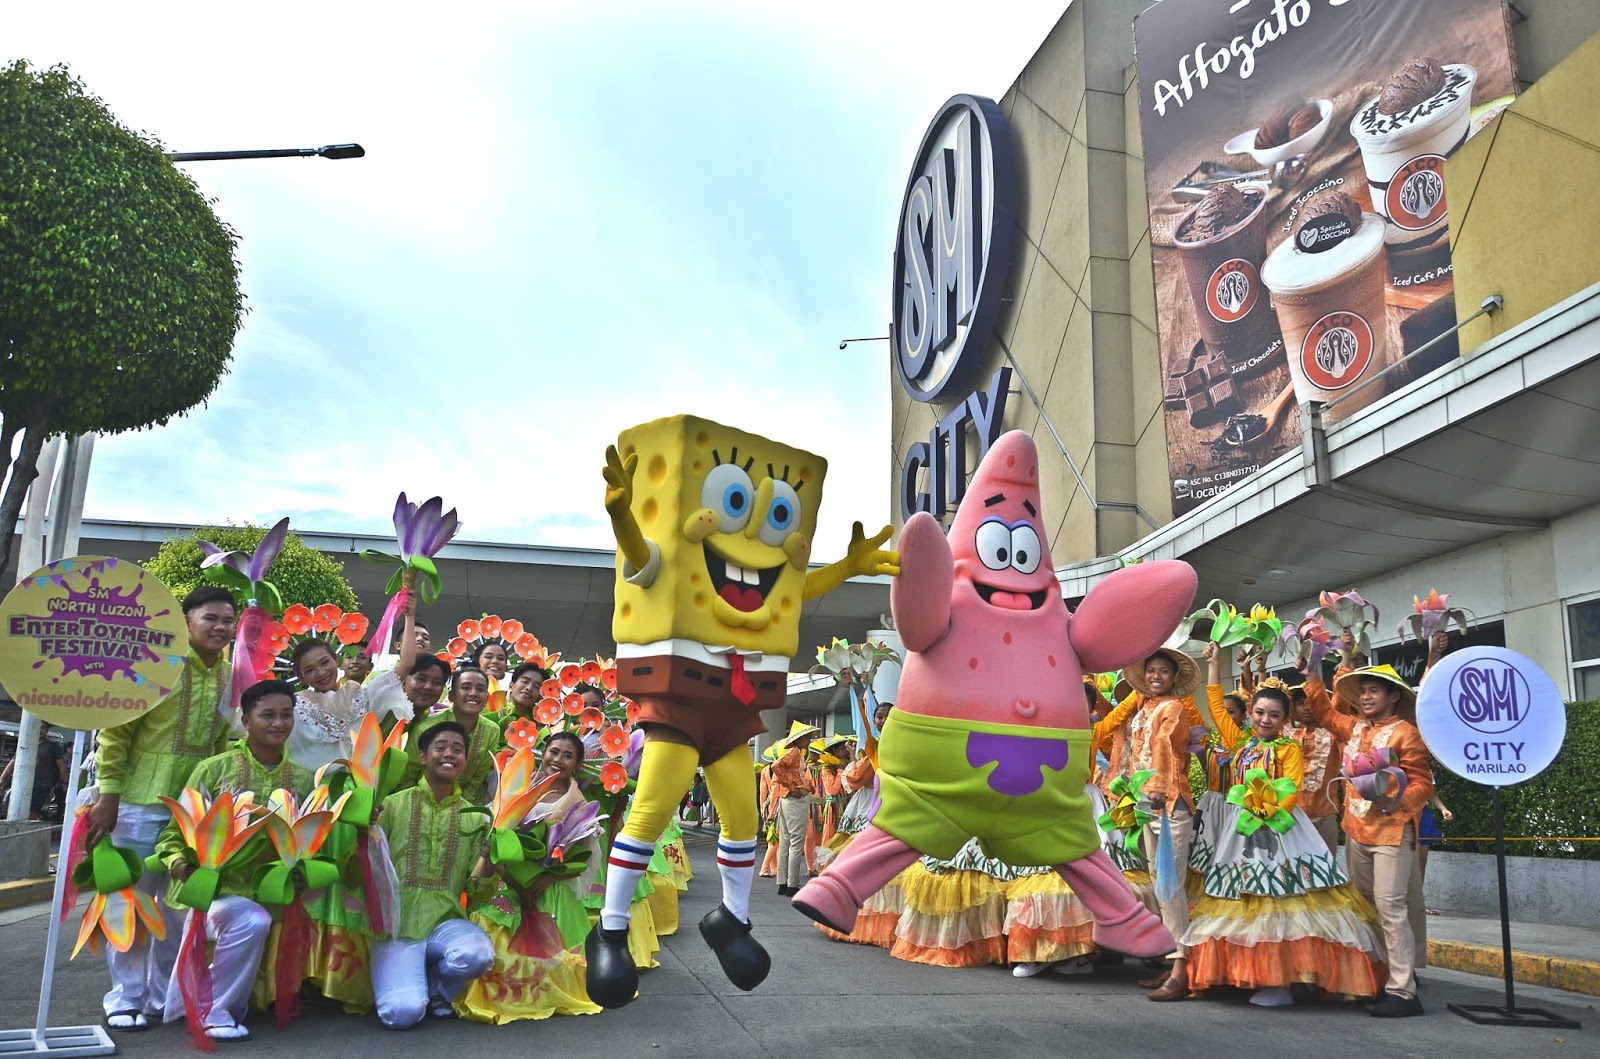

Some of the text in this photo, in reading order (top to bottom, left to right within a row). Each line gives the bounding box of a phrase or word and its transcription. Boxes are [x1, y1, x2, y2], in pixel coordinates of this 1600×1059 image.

[1153, 0, 1311, 117] Affogato
[1282, 207, 1298, 233] Iced
[1320, 221, 1347, 233] Speciale
[904, 110, 983, 380] SM
[1392, 276, 1412, 286] Iced
[1413, 271, 1435, 284] Cafe
[1231, 339, 1282, 374] Iced Chocolate
[901, 367, 1012, 524] CITY
[1202, 476, 1213, 484] No.
[1190, 481, 1232, 499] Located
[88, 587, 110, 600] SM
[49, 599, 145, 618] NORTH LUZON
[40, 638, 143, 661] FESTIVAL
[84, 661, 105, 670] WITH
[16, 687, 148, 711] nickelodeon
[1458, 667, 1519, 723] SM
[1463, 742, 1525, 761] CITY
[1466, 763, 1526, 774] MARILAO
